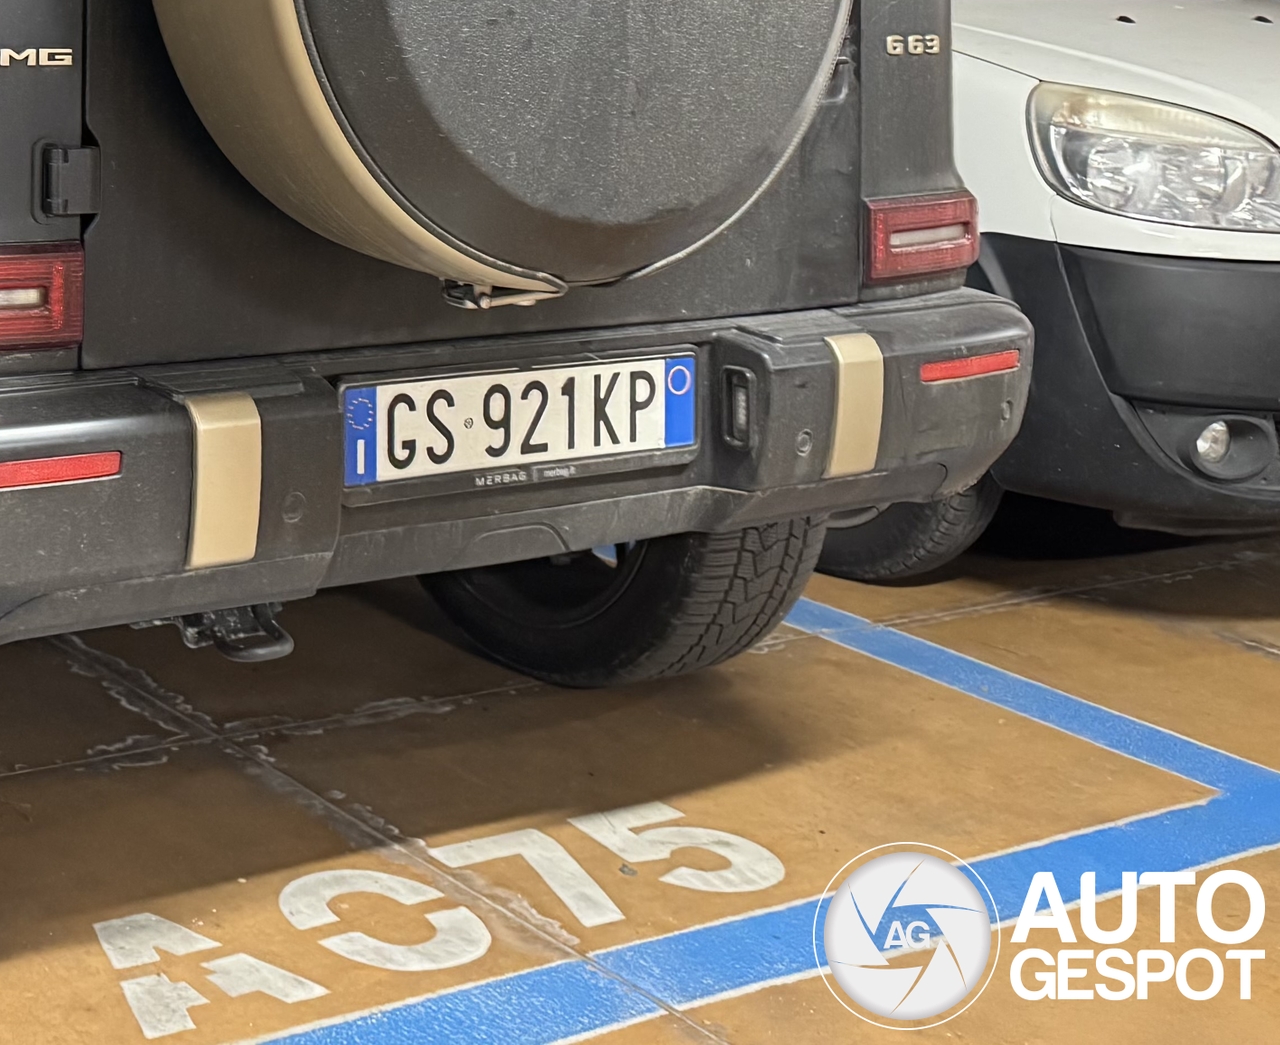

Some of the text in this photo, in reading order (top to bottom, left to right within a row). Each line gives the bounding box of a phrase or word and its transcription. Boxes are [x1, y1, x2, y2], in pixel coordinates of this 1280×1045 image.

[387, 370, 656, 469] GS 921KP
[475, 471, 527, 486] MERBAG
